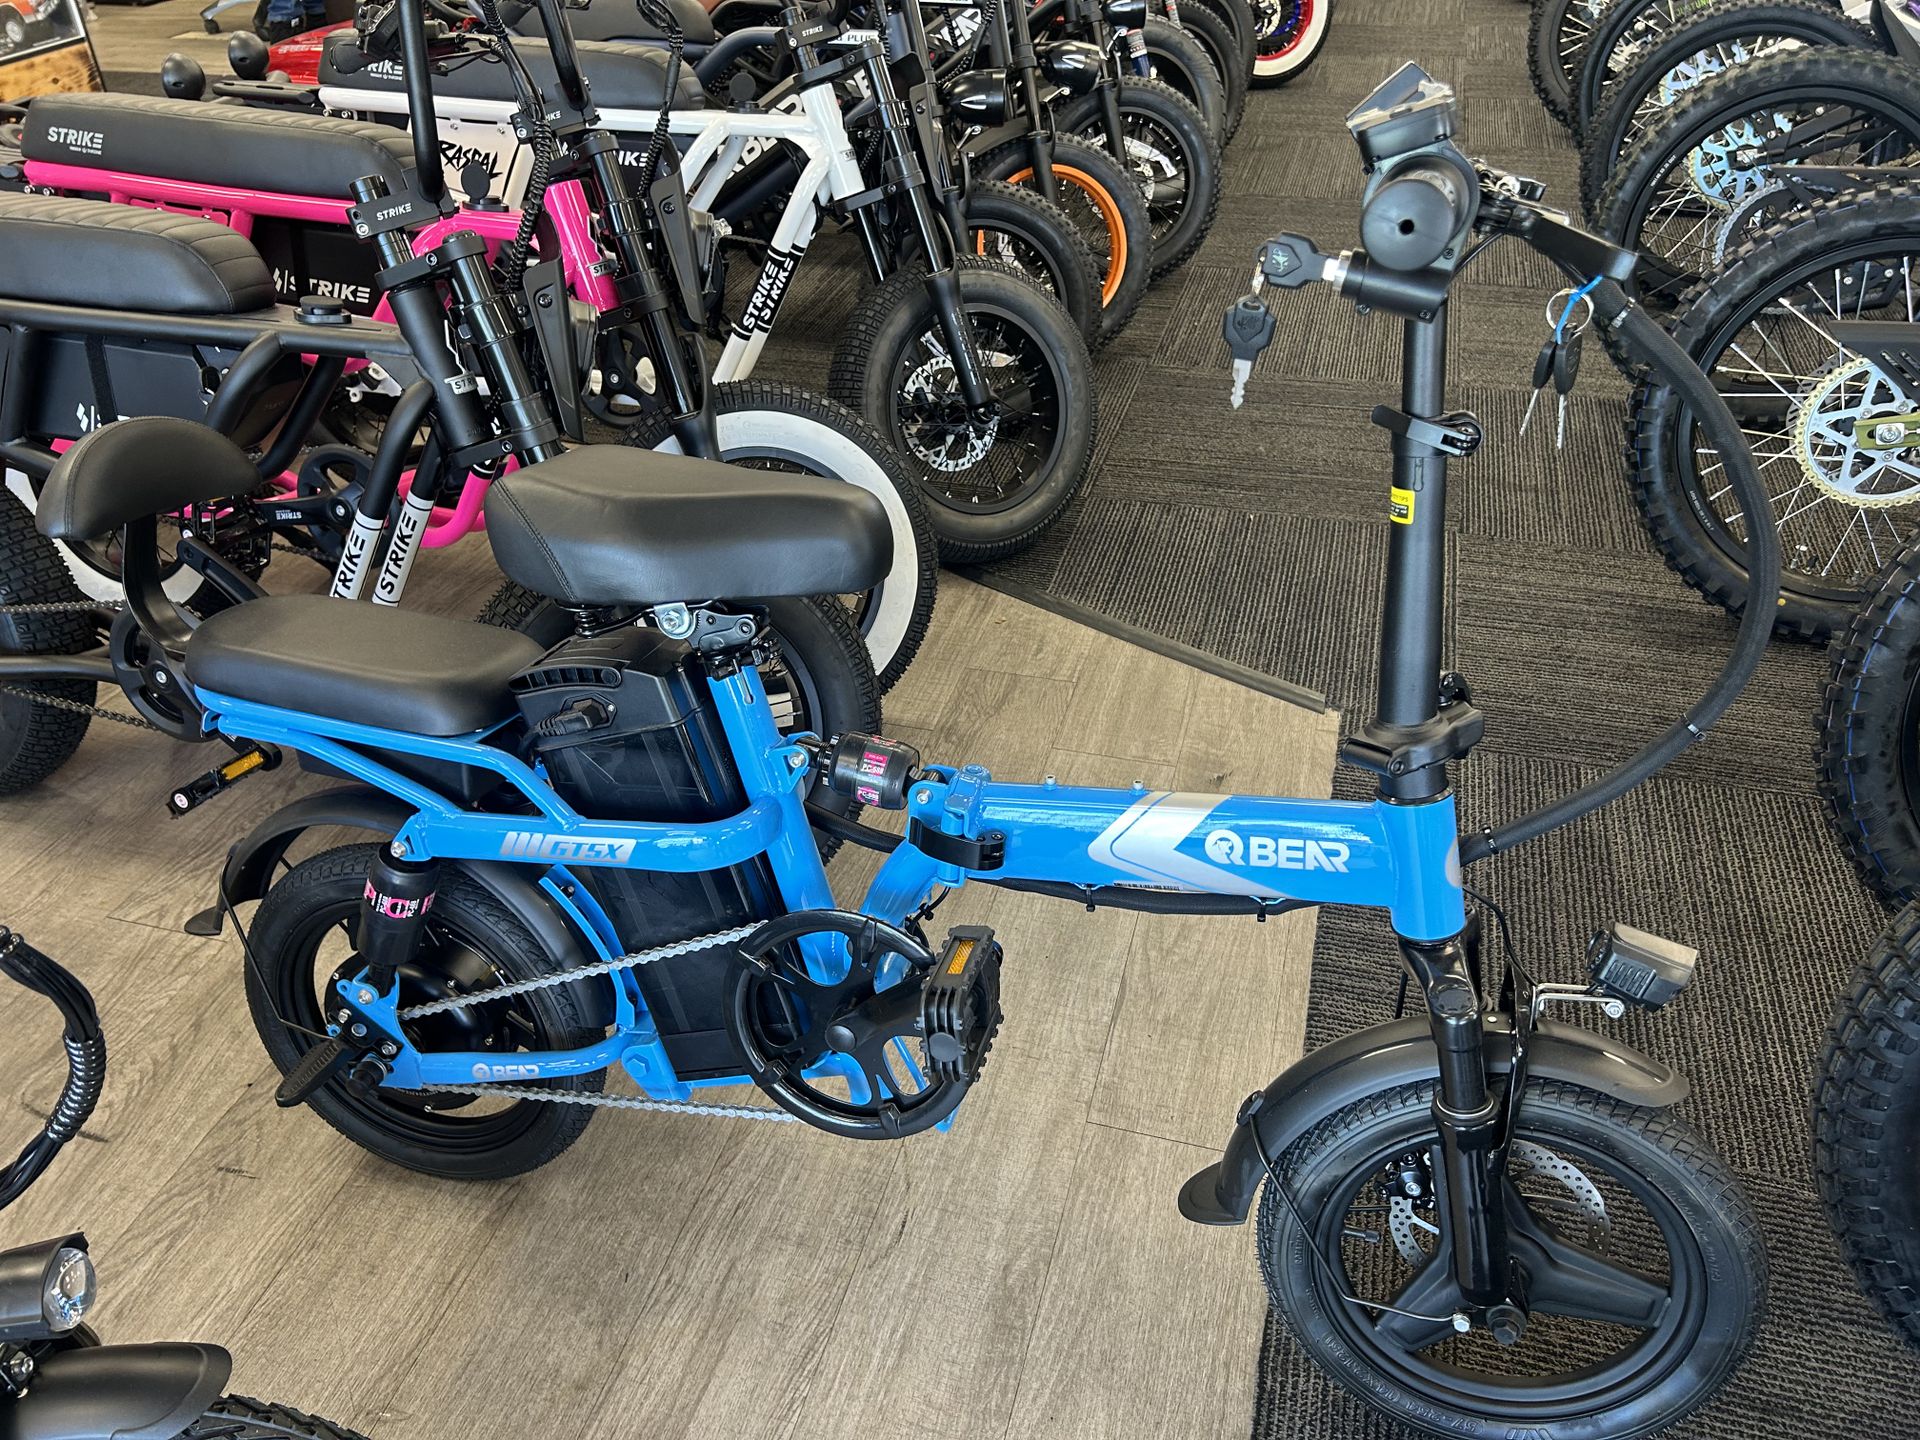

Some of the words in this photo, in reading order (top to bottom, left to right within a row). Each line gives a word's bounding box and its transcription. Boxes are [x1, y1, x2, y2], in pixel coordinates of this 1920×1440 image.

[801, 25, 824, 37] STRIKE
[47, 126, 104, 149] STRIKE
[376, 202, 412, 221] STRIKE
[742, 260, 779, 330] STRIKE
[275, 510, 303, 521] STRIKE
[332, 529, 367, 599] TRIKE
[379, 511, 418, 596] STRIKE
